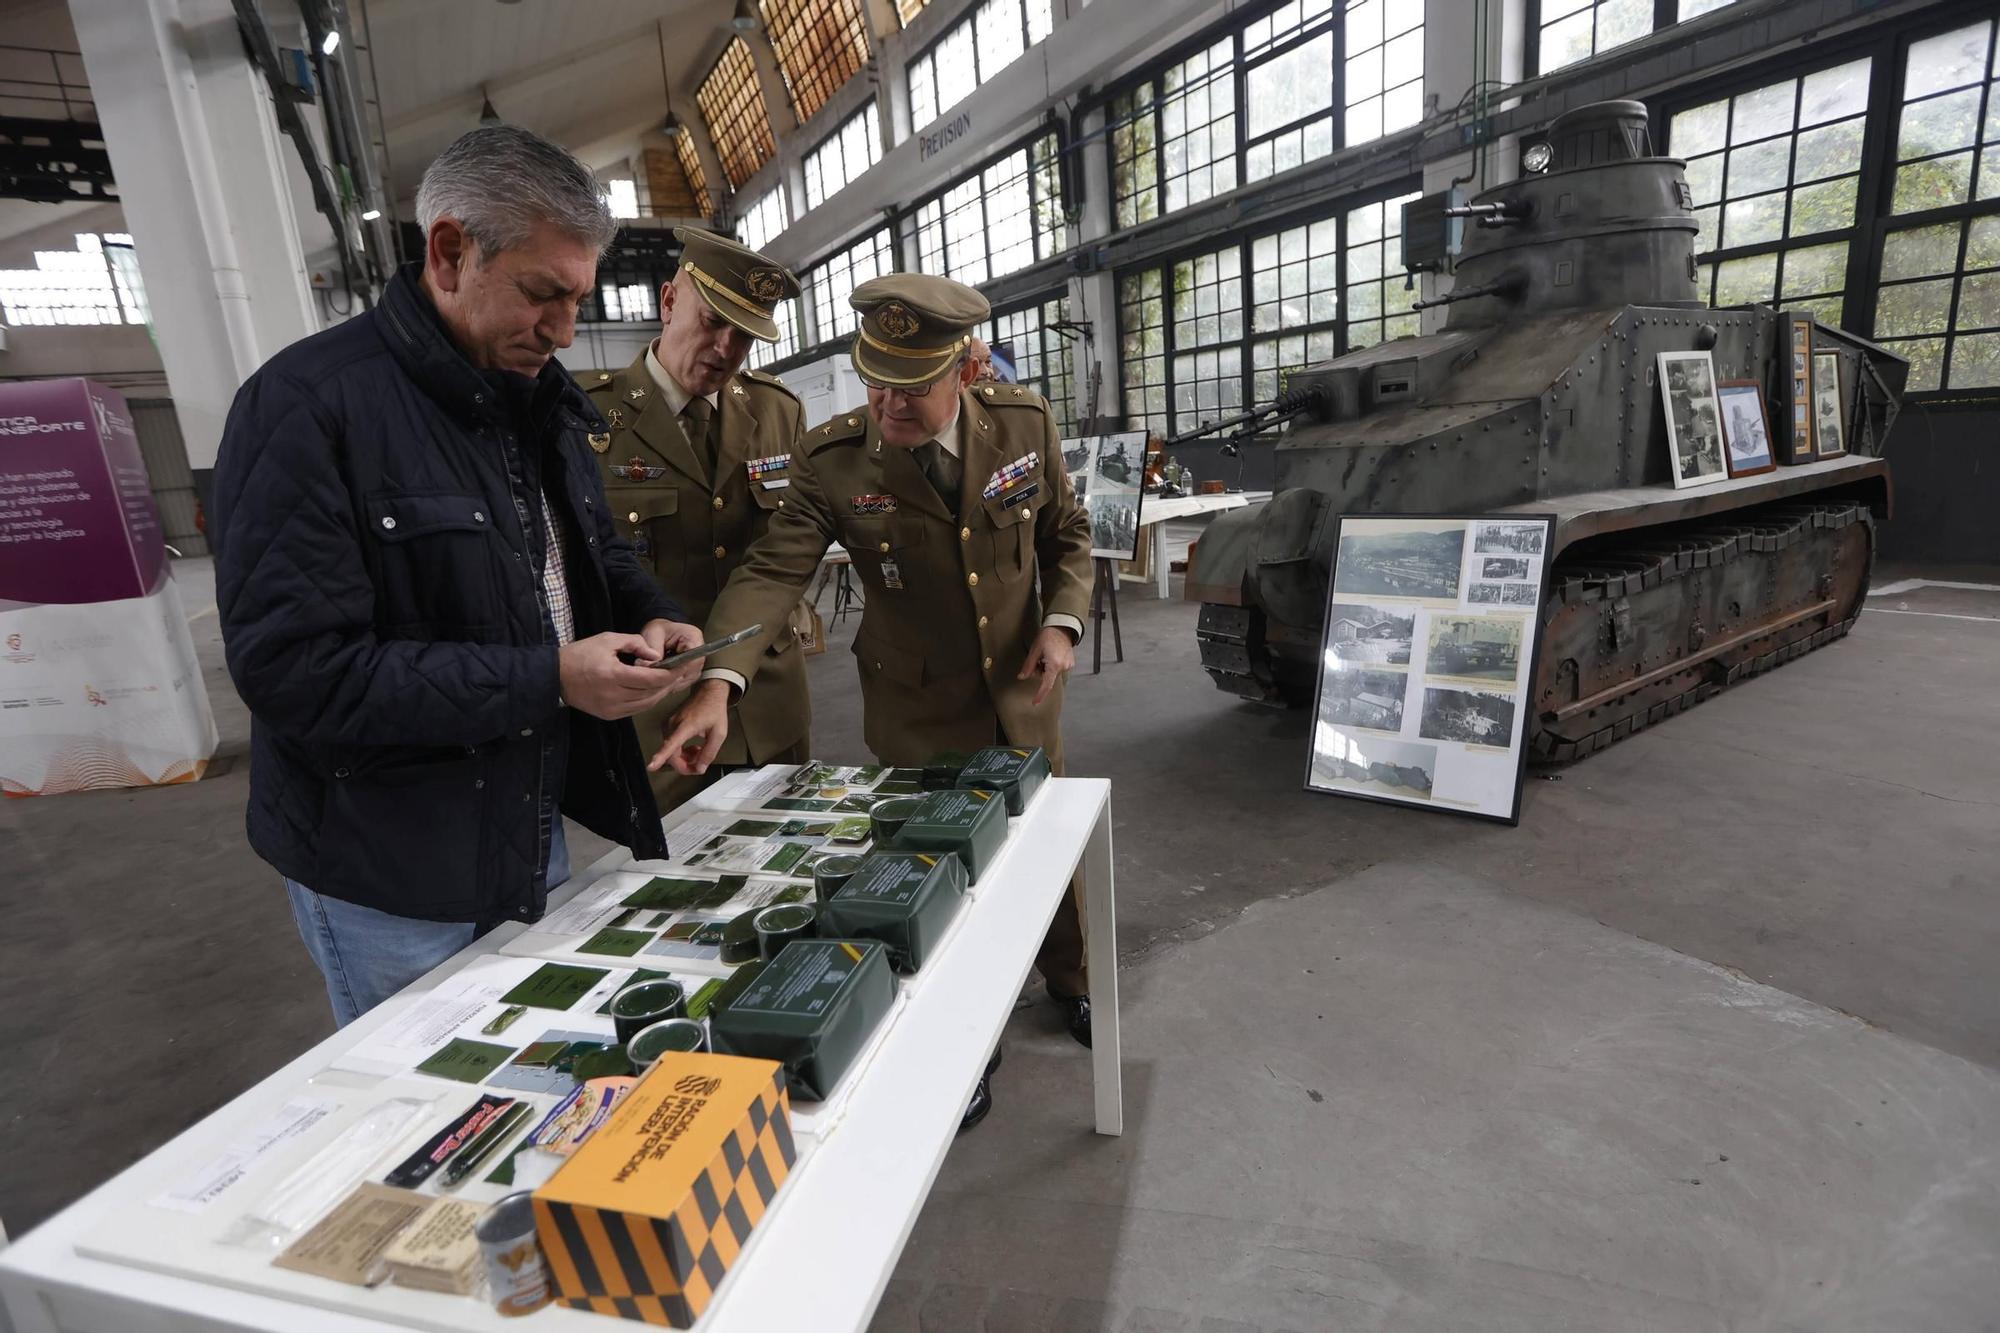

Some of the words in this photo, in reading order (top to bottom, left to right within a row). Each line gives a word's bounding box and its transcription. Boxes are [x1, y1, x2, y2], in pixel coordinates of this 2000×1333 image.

[26, 469, 74, 482] mejorado
[77, 491, 91, 500] de
[635, 1095, 679, 1136] LIGERA
[665, 1099, 707, 1142] RACIÓN
[612, 1097, 693, 1183] INTERVENCIÓN
[648, 1143, 672, 1161] DE
